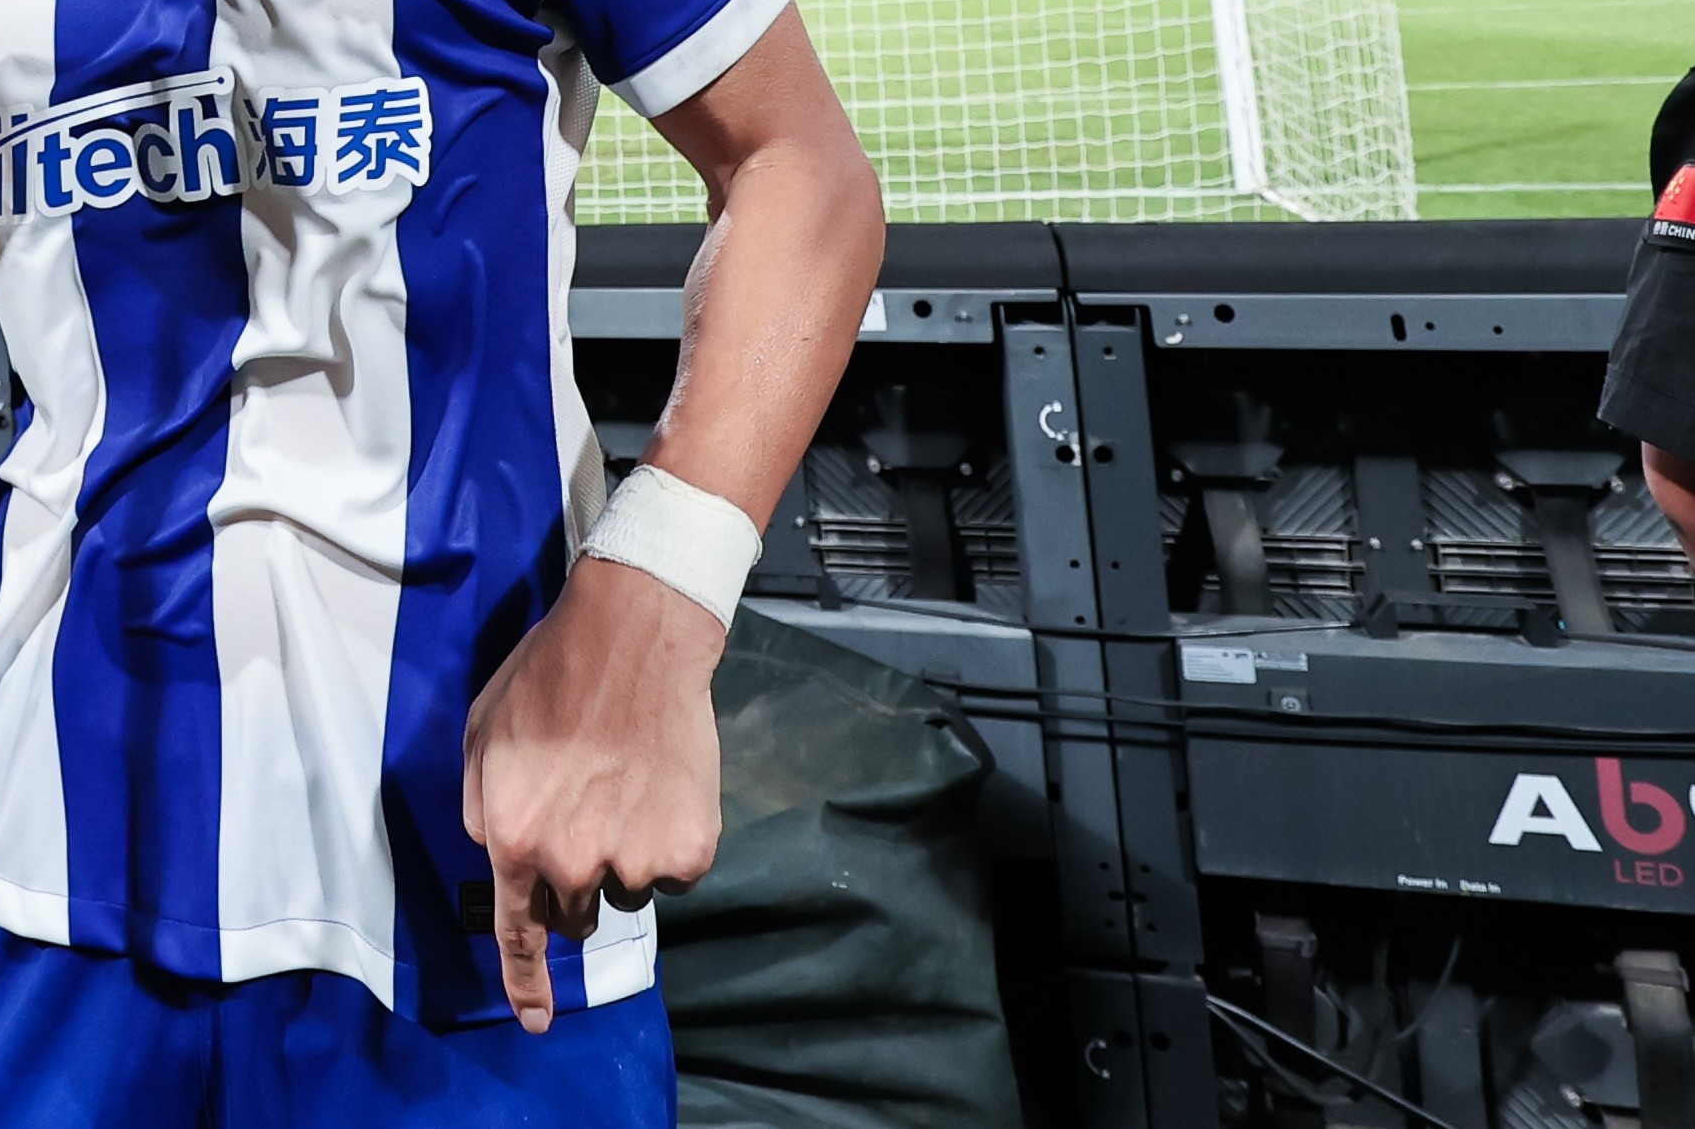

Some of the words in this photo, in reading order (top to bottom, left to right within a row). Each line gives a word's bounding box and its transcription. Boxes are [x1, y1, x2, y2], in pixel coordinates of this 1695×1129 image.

[244, 87, 423, 190] 海泰
[1488, 756, 1695, 855] Ab
[1613, 859, 1685, 887] LED
